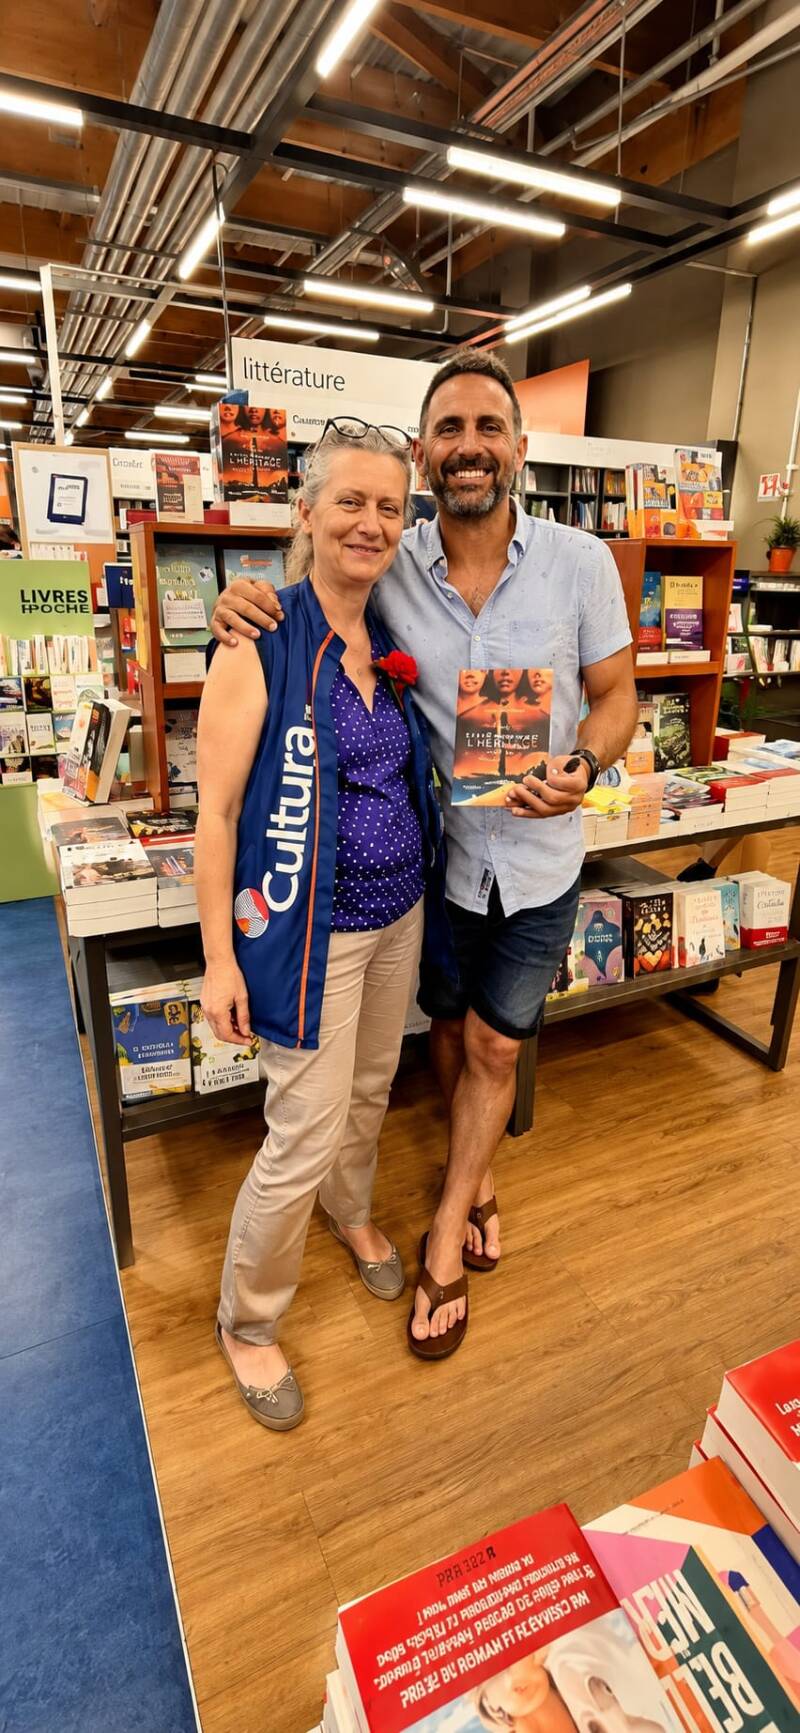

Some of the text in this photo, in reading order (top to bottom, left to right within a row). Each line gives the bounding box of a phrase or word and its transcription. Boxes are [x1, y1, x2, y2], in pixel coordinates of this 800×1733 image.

[243, 356, 346, 391] littérature
[20, 589, 88, 603] LIVRES
[262, 725, 316, 912] Cultura
